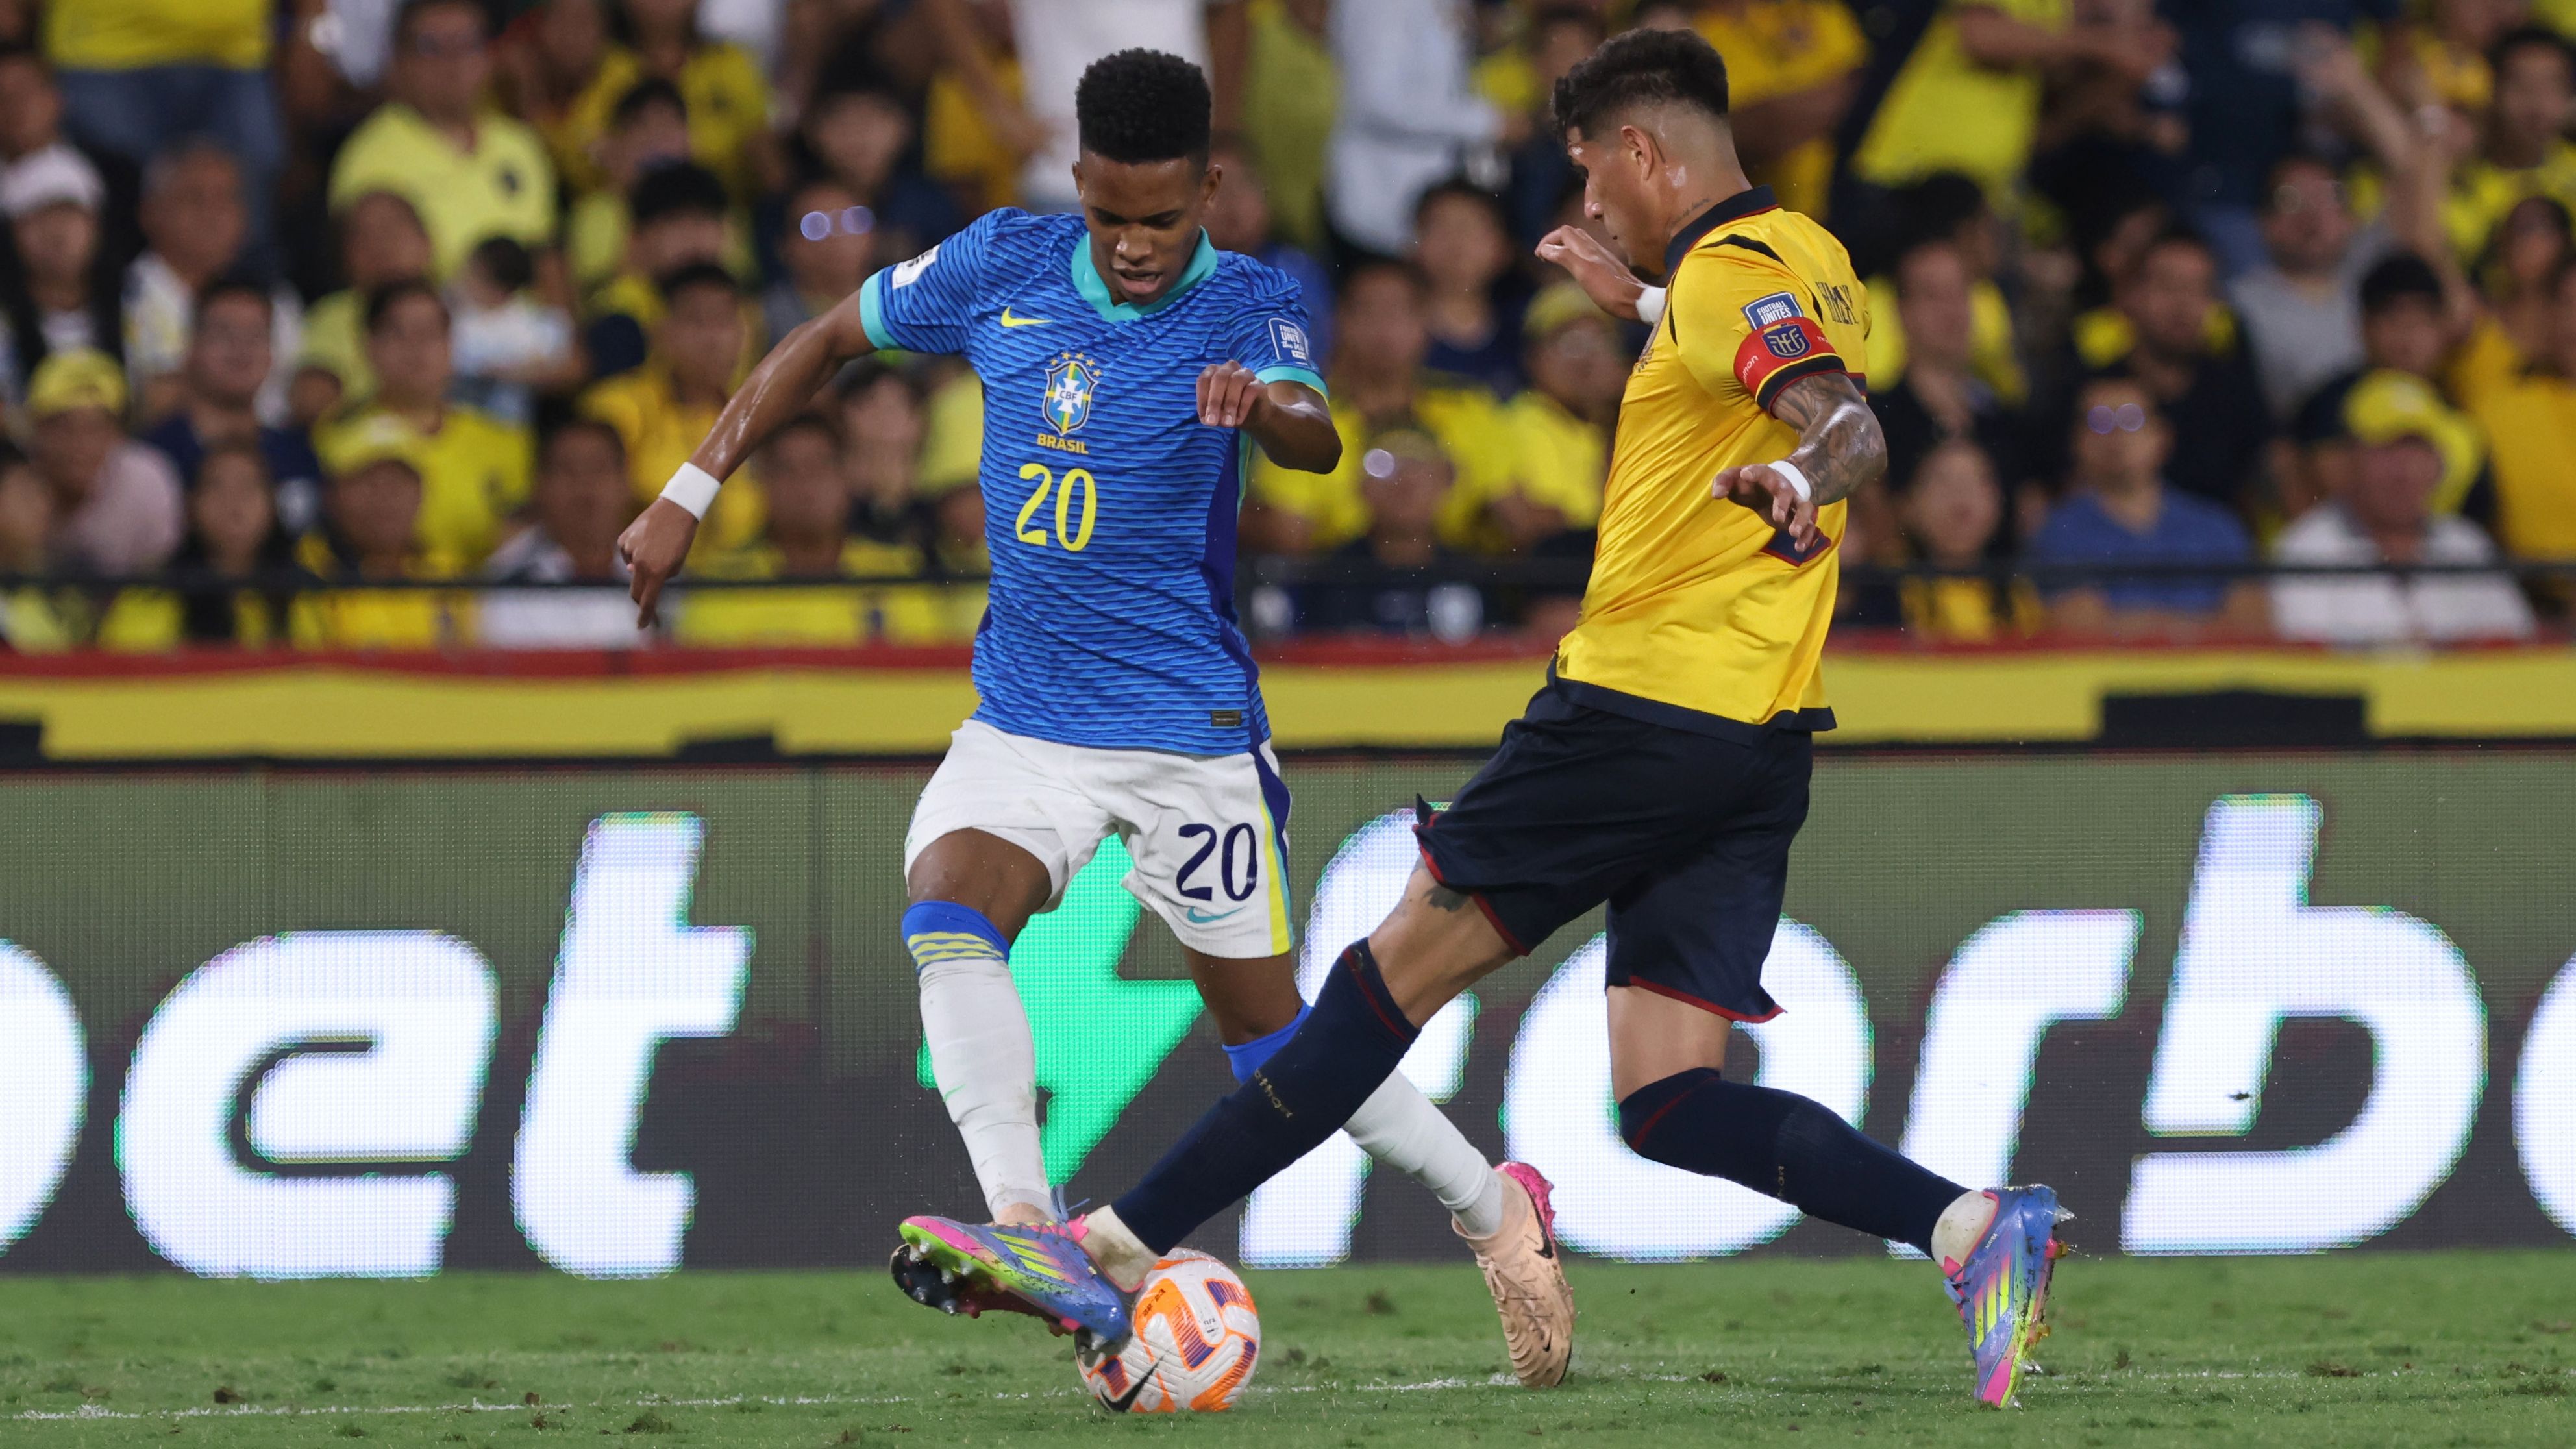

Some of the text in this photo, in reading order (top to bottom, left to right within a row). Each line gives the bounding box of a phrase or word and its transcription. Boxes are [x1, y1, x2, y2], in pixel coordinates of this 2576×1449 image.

[1756, 301, 1788, 316] FOOTBALL
[1760, 307, 1792, 325] UNITES
[1059, 390, 1078, 401] CBF
[1037, 433, 1089, 454] BRASIL
[1015, 463, 1097, 551] 20
[1176, 823, 1257, 901] 20
[0, 811, 755, 1280] et
[1238, 793, 2576, 1270] forb
